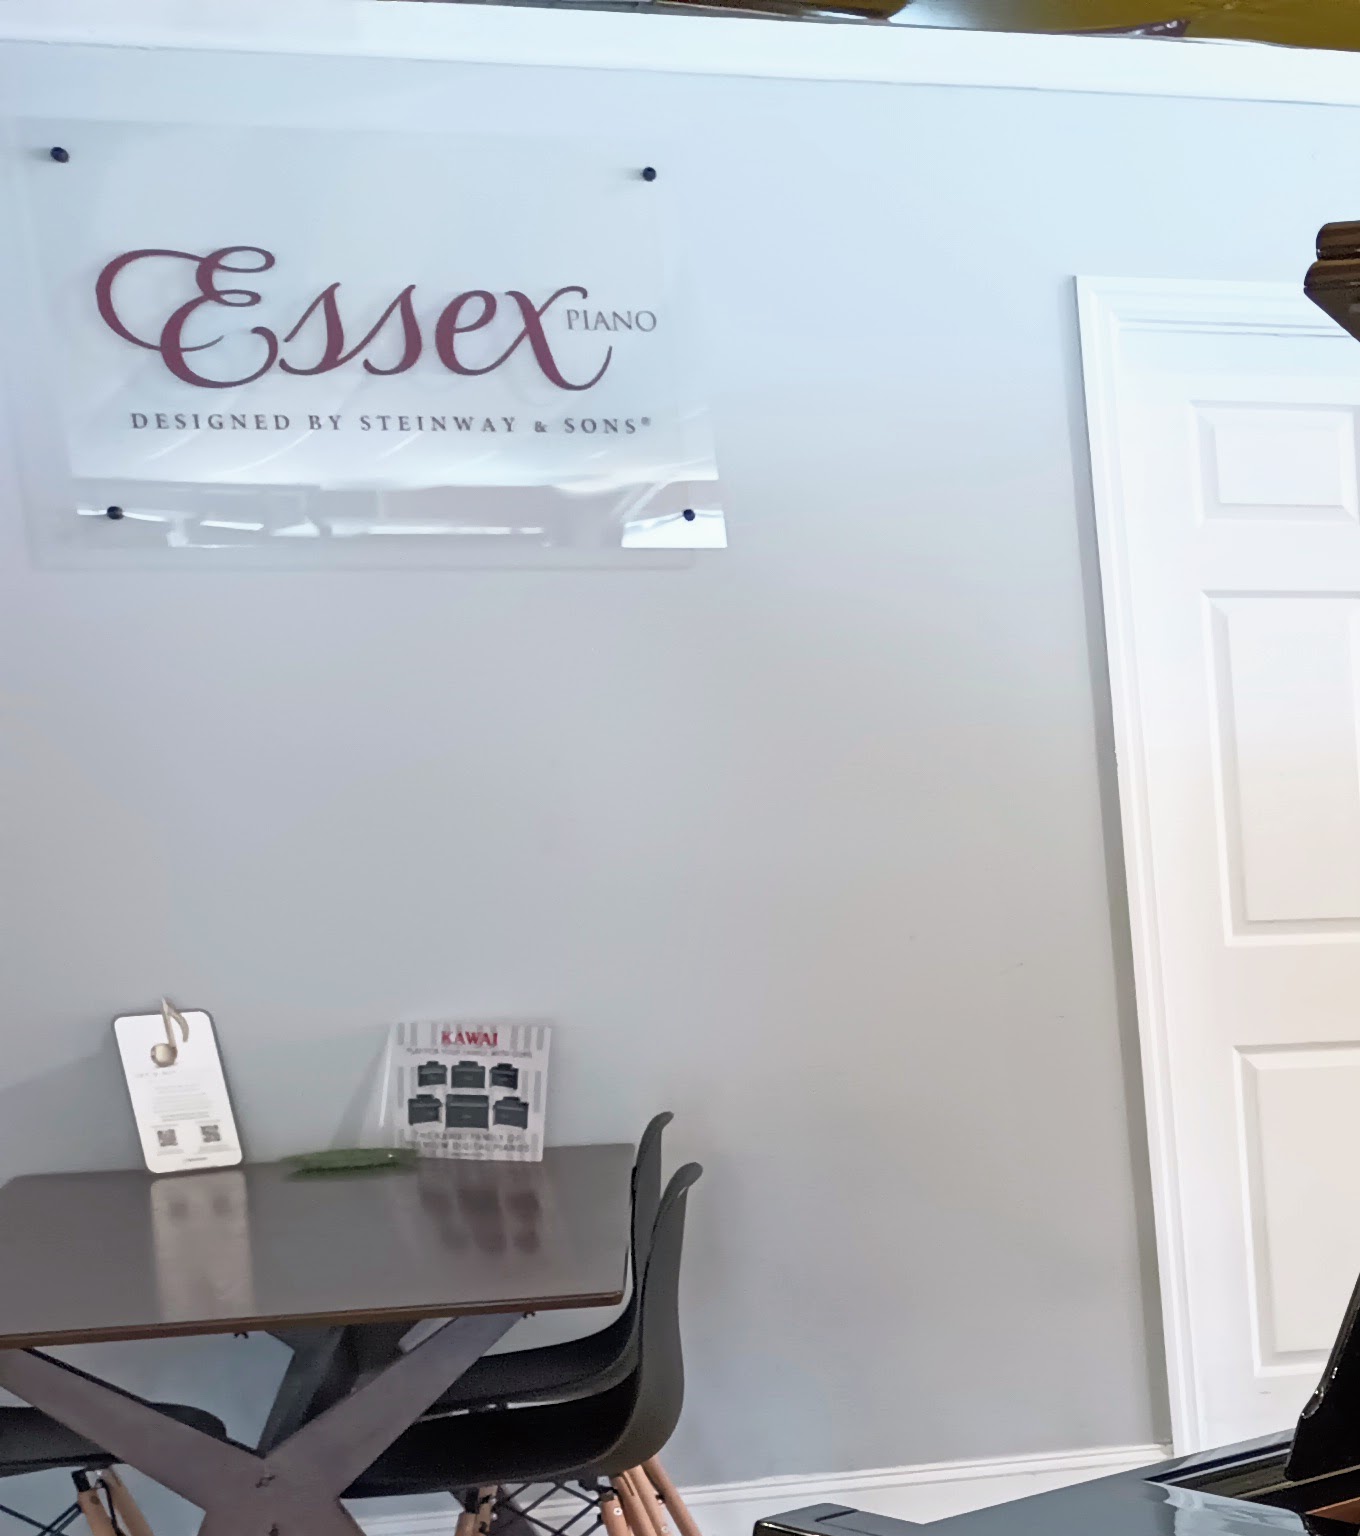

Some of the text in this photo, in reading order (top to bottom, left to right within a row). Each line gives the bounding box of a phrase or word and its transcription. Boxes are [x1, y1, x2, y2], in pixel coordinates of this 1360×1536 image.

[95, 246, 612, 391] Essex
[565, 309, 658, 332] PIANO
[130, 412, 290, 430] DESIGNED
[308, 414, 342, 432] BY
[359, 415, 516, 433] STEINWAY
[534, 419, 549, 434] &
[441, 1030, 498, 1047] KAWAI
